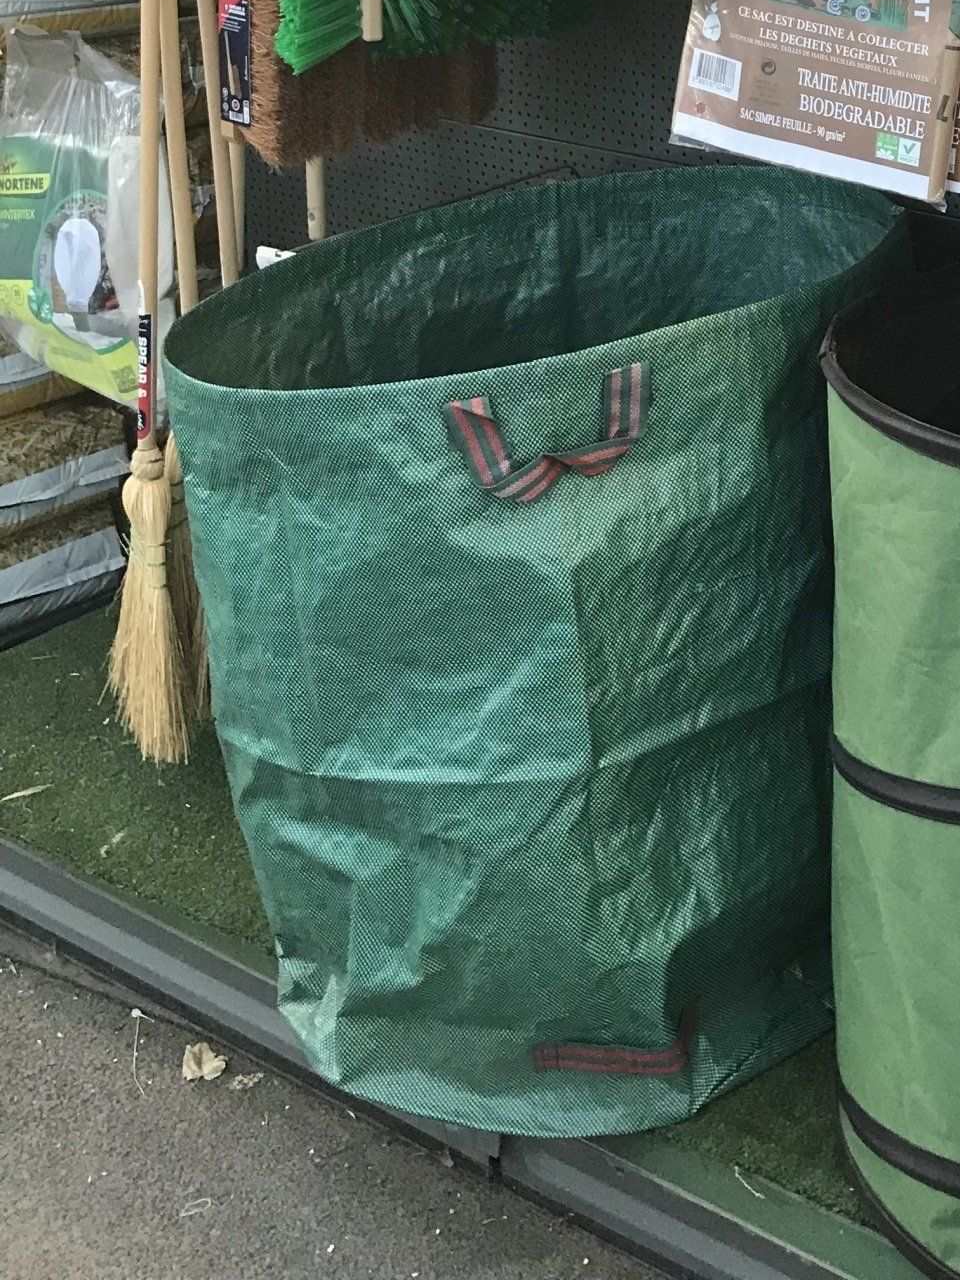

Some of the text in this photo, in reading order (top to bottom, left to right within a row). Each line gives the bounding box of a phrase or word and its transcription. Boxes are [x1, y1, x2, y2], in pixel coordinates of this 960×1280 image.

[738, 6, 929, 57] CE SAC EST DESTINE A COLLECTER
[759, 27, 898, 68] LES DECHETS VEGETAUX
[797, 68, 840, 91] TRAITE
[840, 78, 932, 115] ANTI-HUMIDITE
[740, 107, 825, 138] SAC SIMPLE FEUILLE 90
[799, 94, 925, 139] BIODEGRADABLE
[137, 336, 148, 399] SPEAR &
